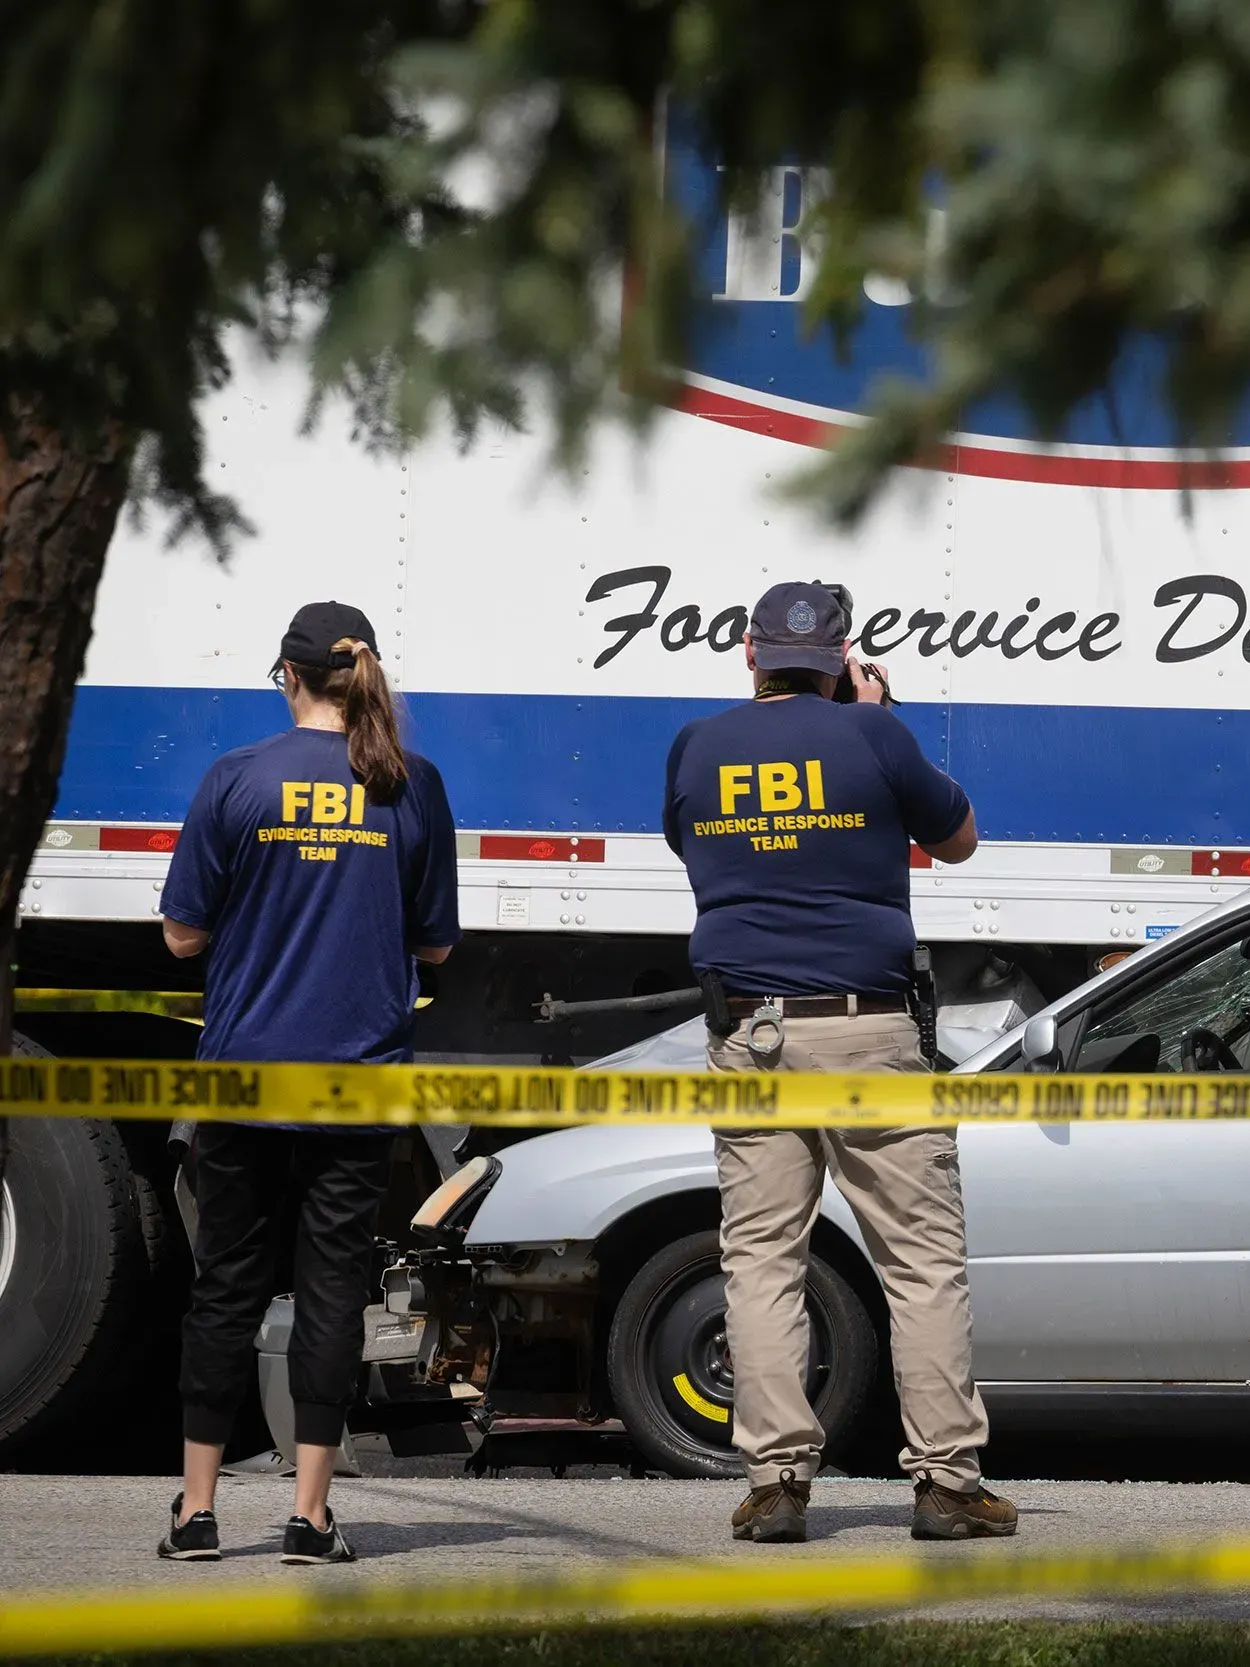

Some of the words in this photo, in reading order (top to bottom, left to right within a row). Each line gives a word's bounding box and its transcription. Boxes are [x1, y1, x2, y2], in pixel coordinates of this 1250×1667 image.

[586, 565, 1122, 669] Fooervice
[281, 781, 366, 825] FBI
[719, 759, 826, 815] FBI
[258, 827, 318, 843] EVIDENCE
[320, 830, 388, 847] RESPONSE
[694, 817, 769, 836] EVIDENCE
[774, 813, 866, 832] RESPONSE
[750, 835, 799, 851] TEAM
[298, 846, 337, 861] TEAM
[56, 1064, 92, 1104] DO
[103, 1065, 160, 1105] LINE
[171, 1067, 260, 1107] POLICE
[412, 1072, 498, 1113] CROSS
[511, 1073, 564, 1113] NOT
[575, 1075, 610, 1115] DO
[620, 1076, 679, 1116] LINE
[688, 1077, 779, 1117] POLICE
[931, 1081, 1018, 1118] CROSS
[1029, 1081, 1083, 1120] NOT
[1093, 1081, 1129, 1119] DO
[1140, 1080, 1198, 1118] LINE
